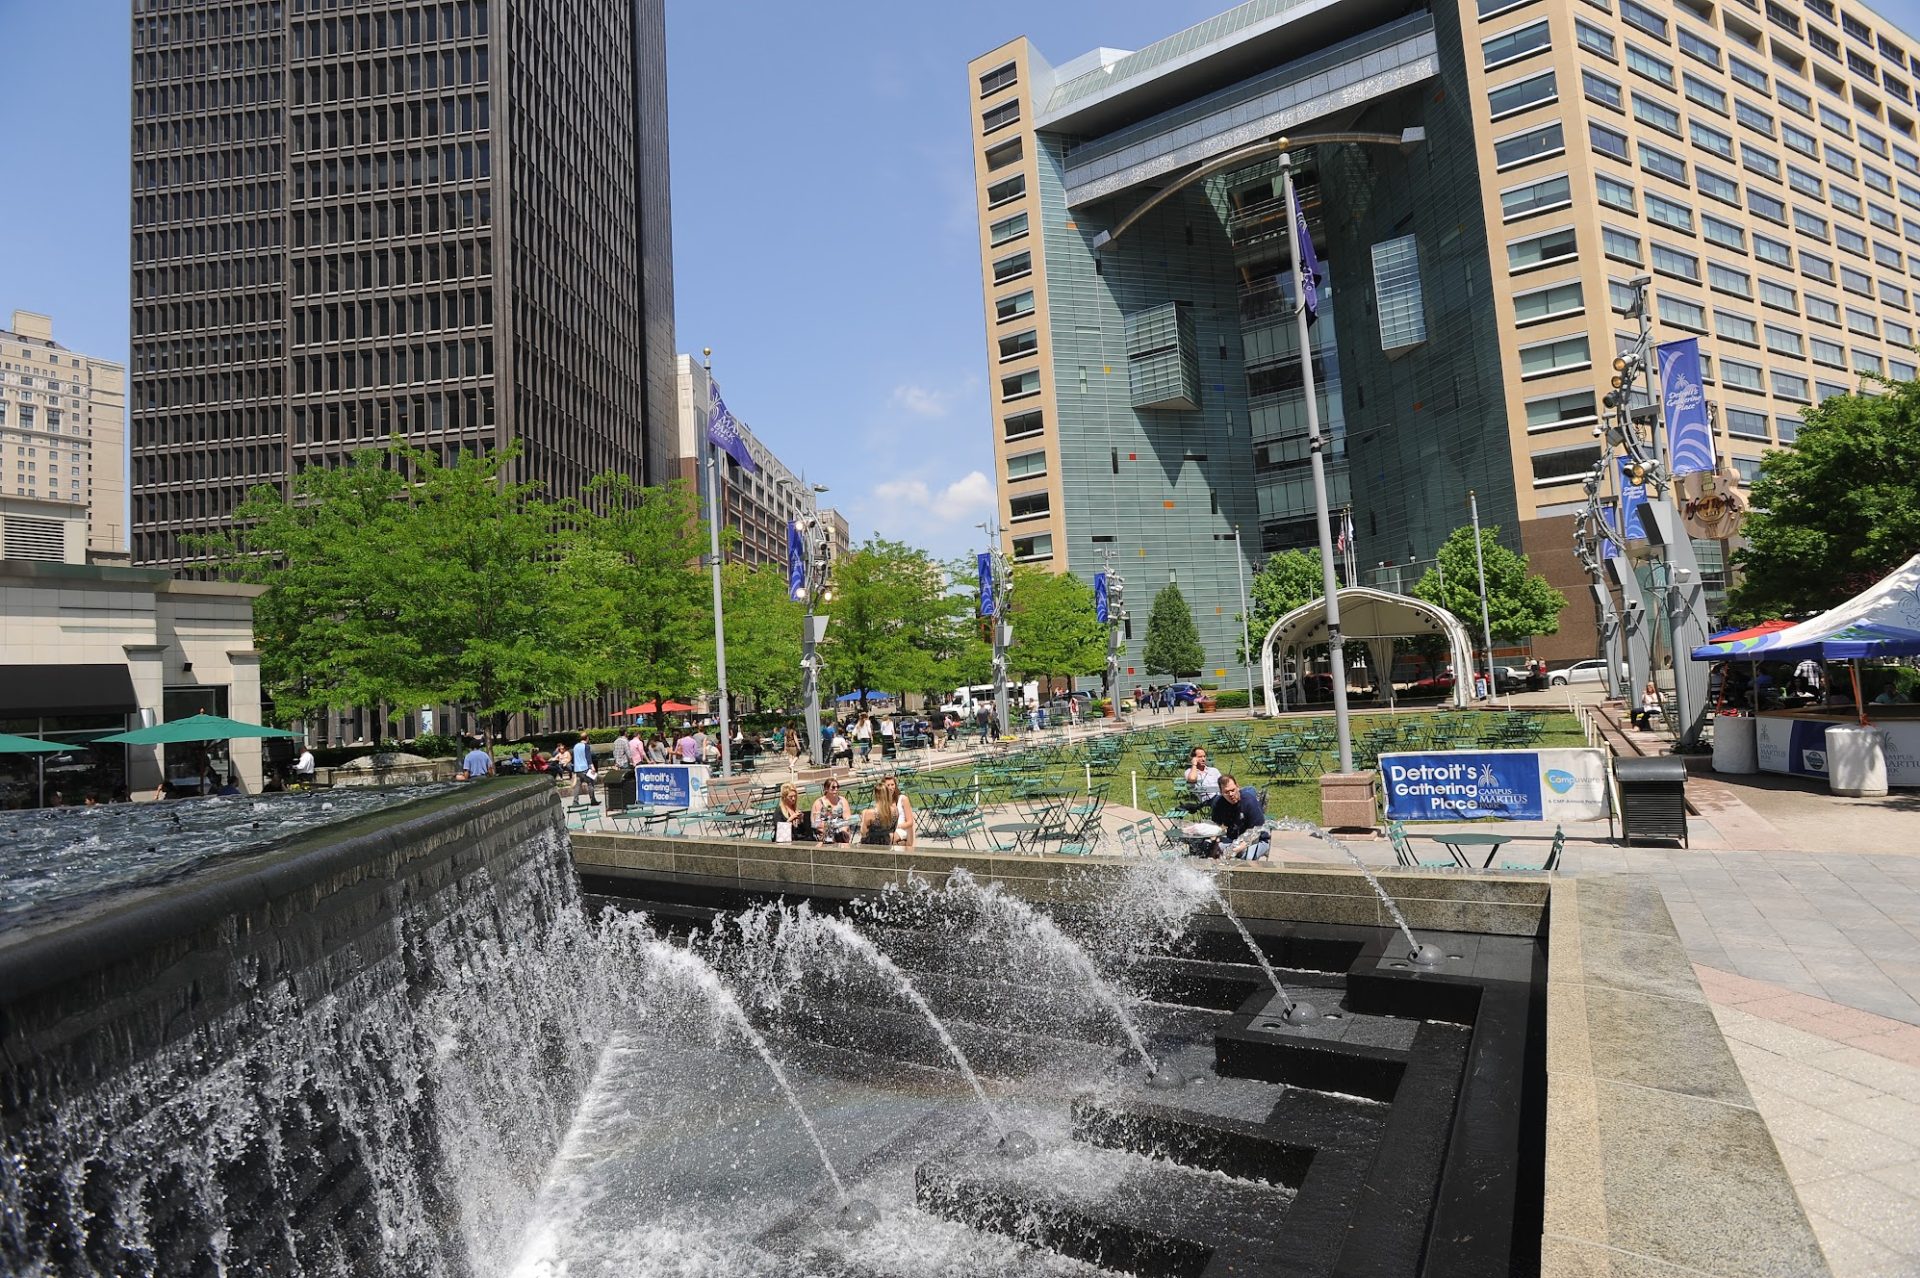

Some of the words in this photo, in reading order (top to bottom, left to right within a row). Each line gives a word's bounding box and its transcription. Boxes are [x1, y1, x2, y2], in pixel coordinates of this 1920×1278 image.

[1391, 764, 1478, 781] Detroit's
[1550, 775, 1601, 785] Compuware
[652, 792, 670, 800] Place
[1395, 783, 1478, 798] Gathering
[1431, 797, 1478, 810] Place
[1479, 795, 1528, 803] MARTIUS
